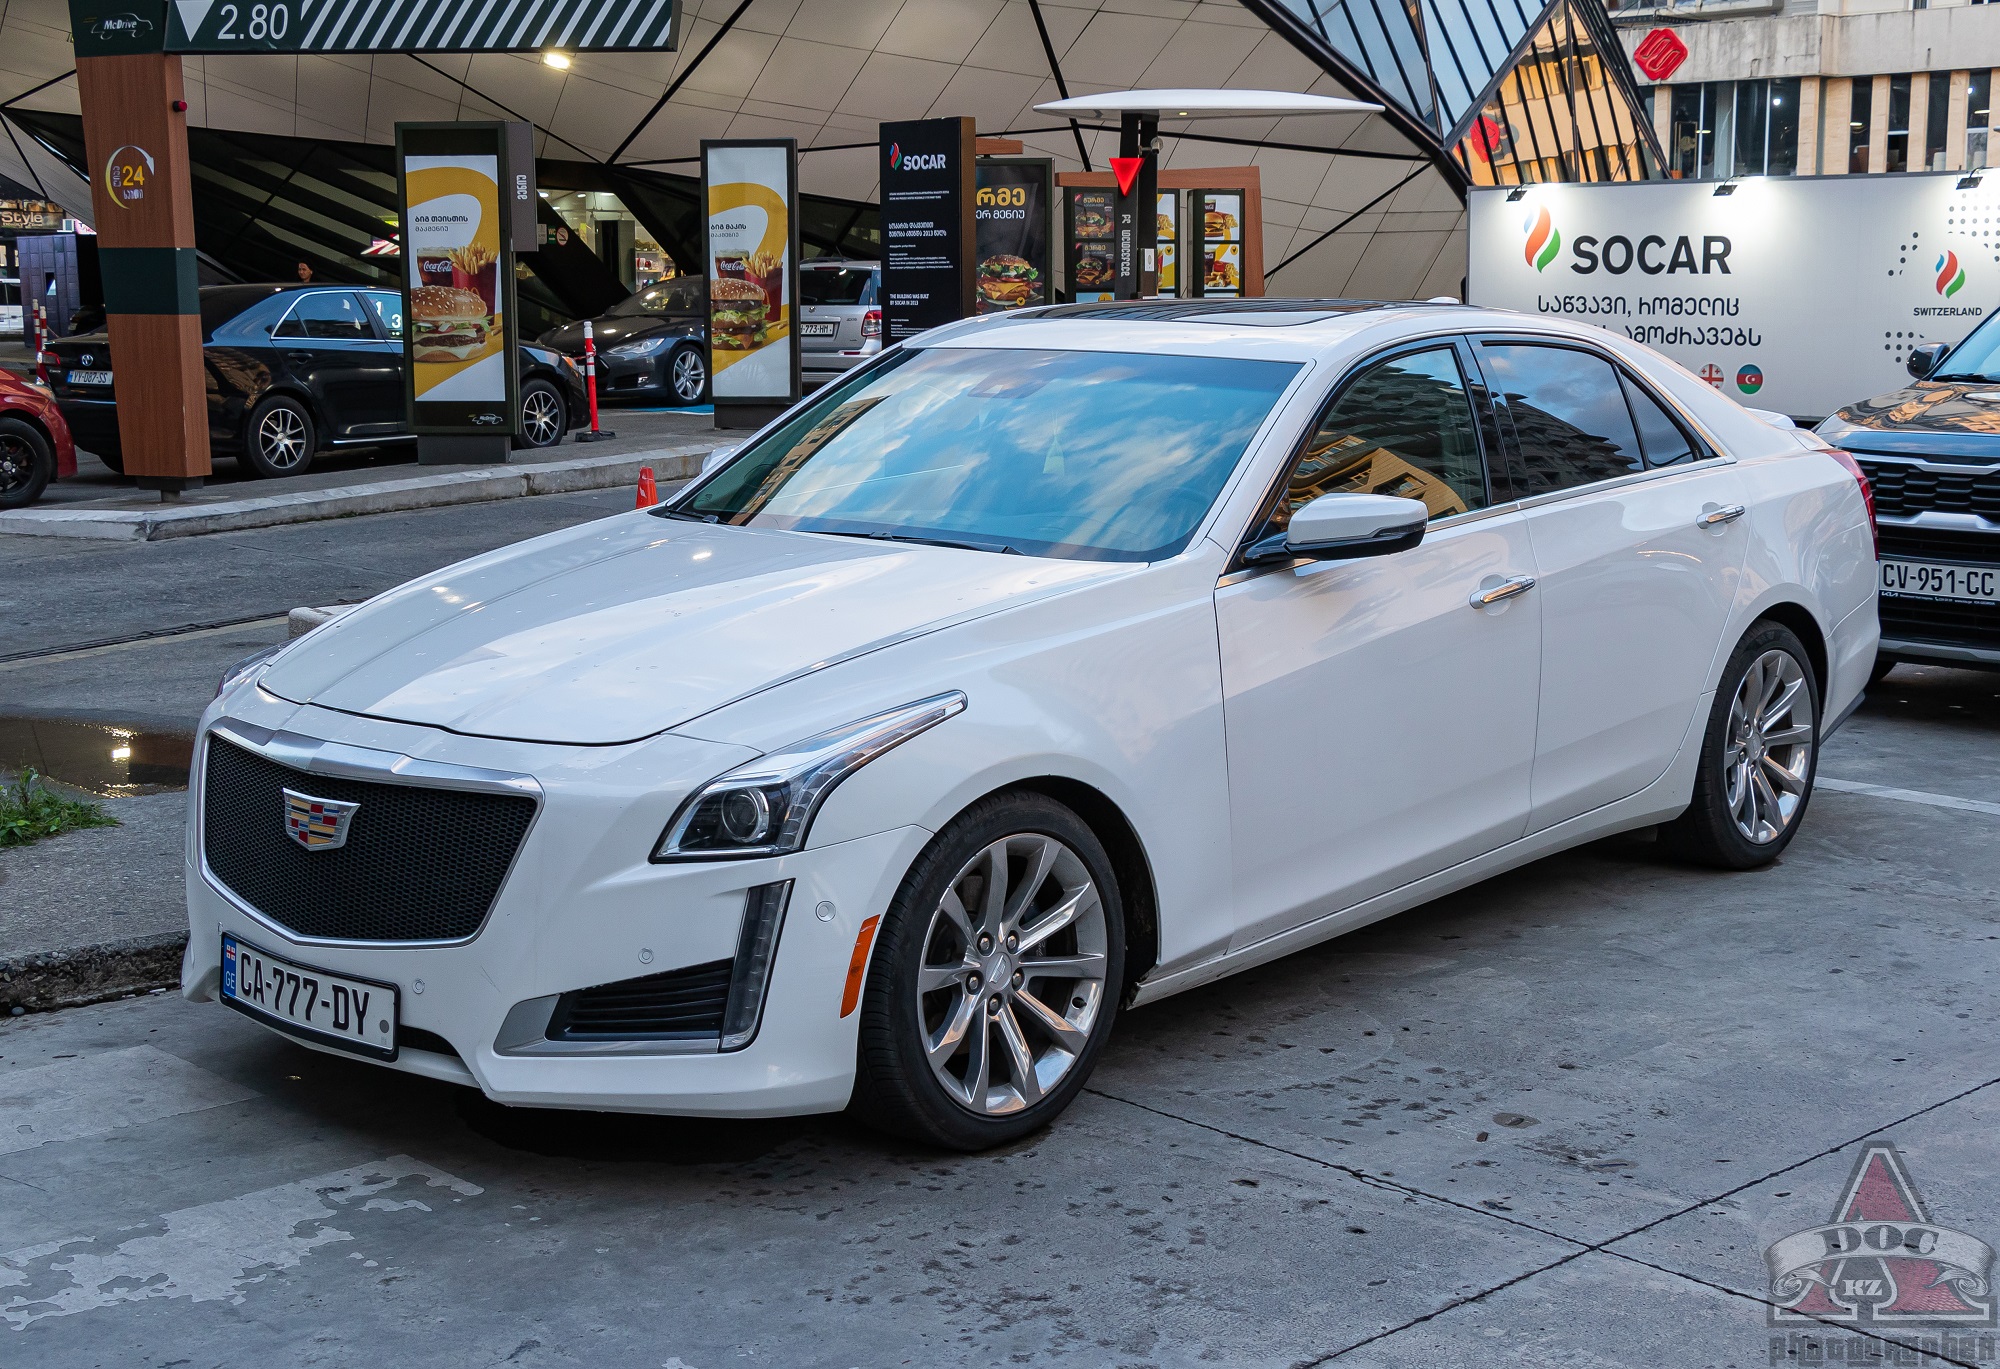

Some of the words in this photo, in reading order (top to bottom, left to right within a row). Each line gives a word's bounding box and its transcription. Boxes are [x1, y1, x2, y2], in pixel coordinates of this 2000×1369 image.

[103, 19, 138, 31] McDrive
[217, 4, 289, 40] 2.80
[903, 154, 946, 171] SOCAR
[122, 165, 145, 187] 24
[516, 174, 528, 200] მენიუ
[976, 187, 1026, 207] რმე
[1, 210, 44, 225] Style
[993, 209, 1026, 220] მენიუ
[1570, 234, 1732, 275] SOCAR
[1537, 295, 1632, 317] საწვავი,
[1638, 296, 1740, 317] რომელიც
[1913, 307, 1983, 316] SWITZERLAND
[1883, 563, 1994, 597] CV-951-CC
[225, 970, 235, 990] GE
[240, 951, 370, 1036] CA-777-DY
